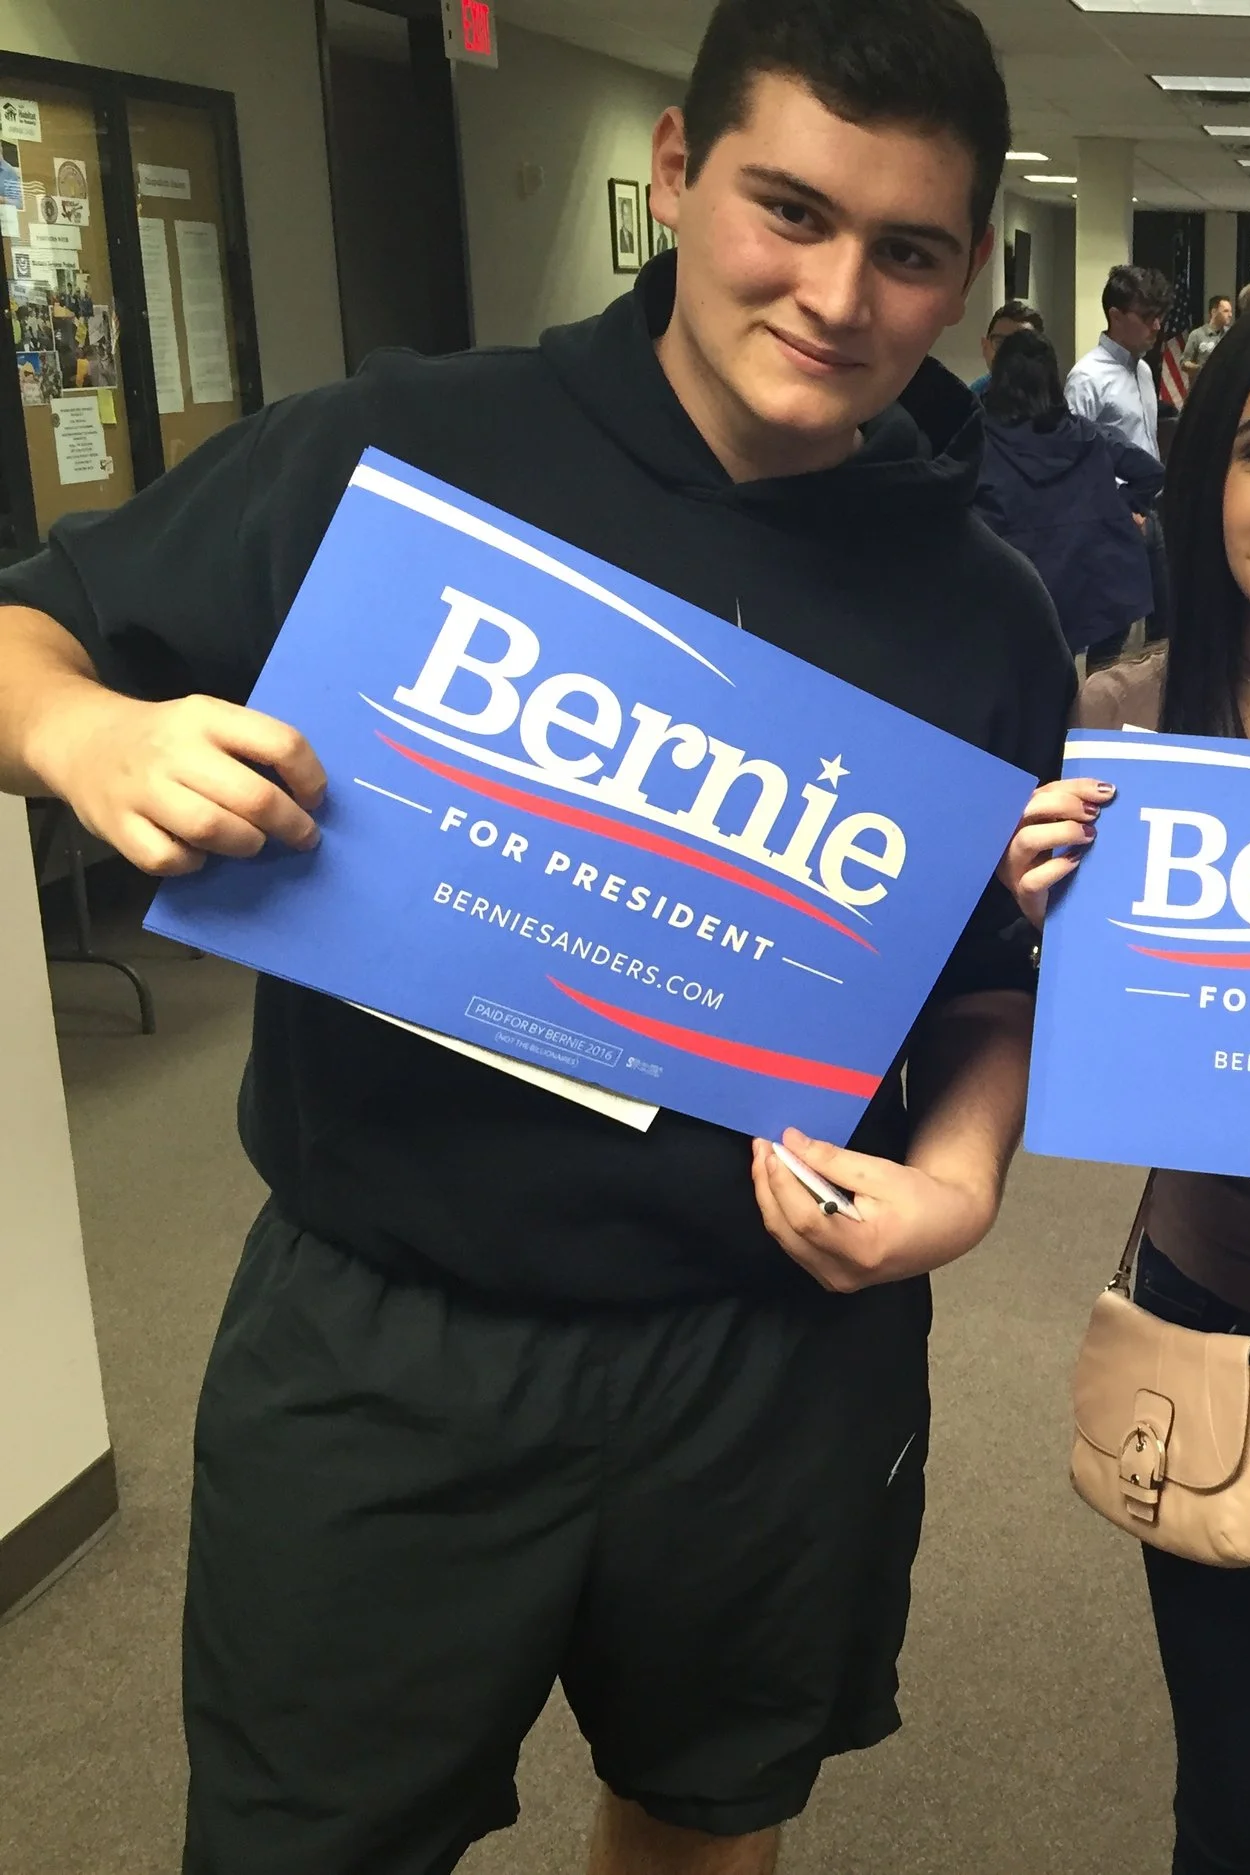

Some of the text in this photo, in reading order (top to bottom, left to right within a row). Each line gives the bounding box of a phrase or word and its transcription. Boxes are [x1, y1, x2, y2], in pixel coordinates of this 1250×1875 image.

[393, 585, 908, 908] Bernie
[432, 881, 726, 1011] BERNIESANDERS.COM
[439, 807, 776, 961] FOR PRESIDENT
[475, 1004, 613, 1061] PAID FOR BY BERNIE 2016
